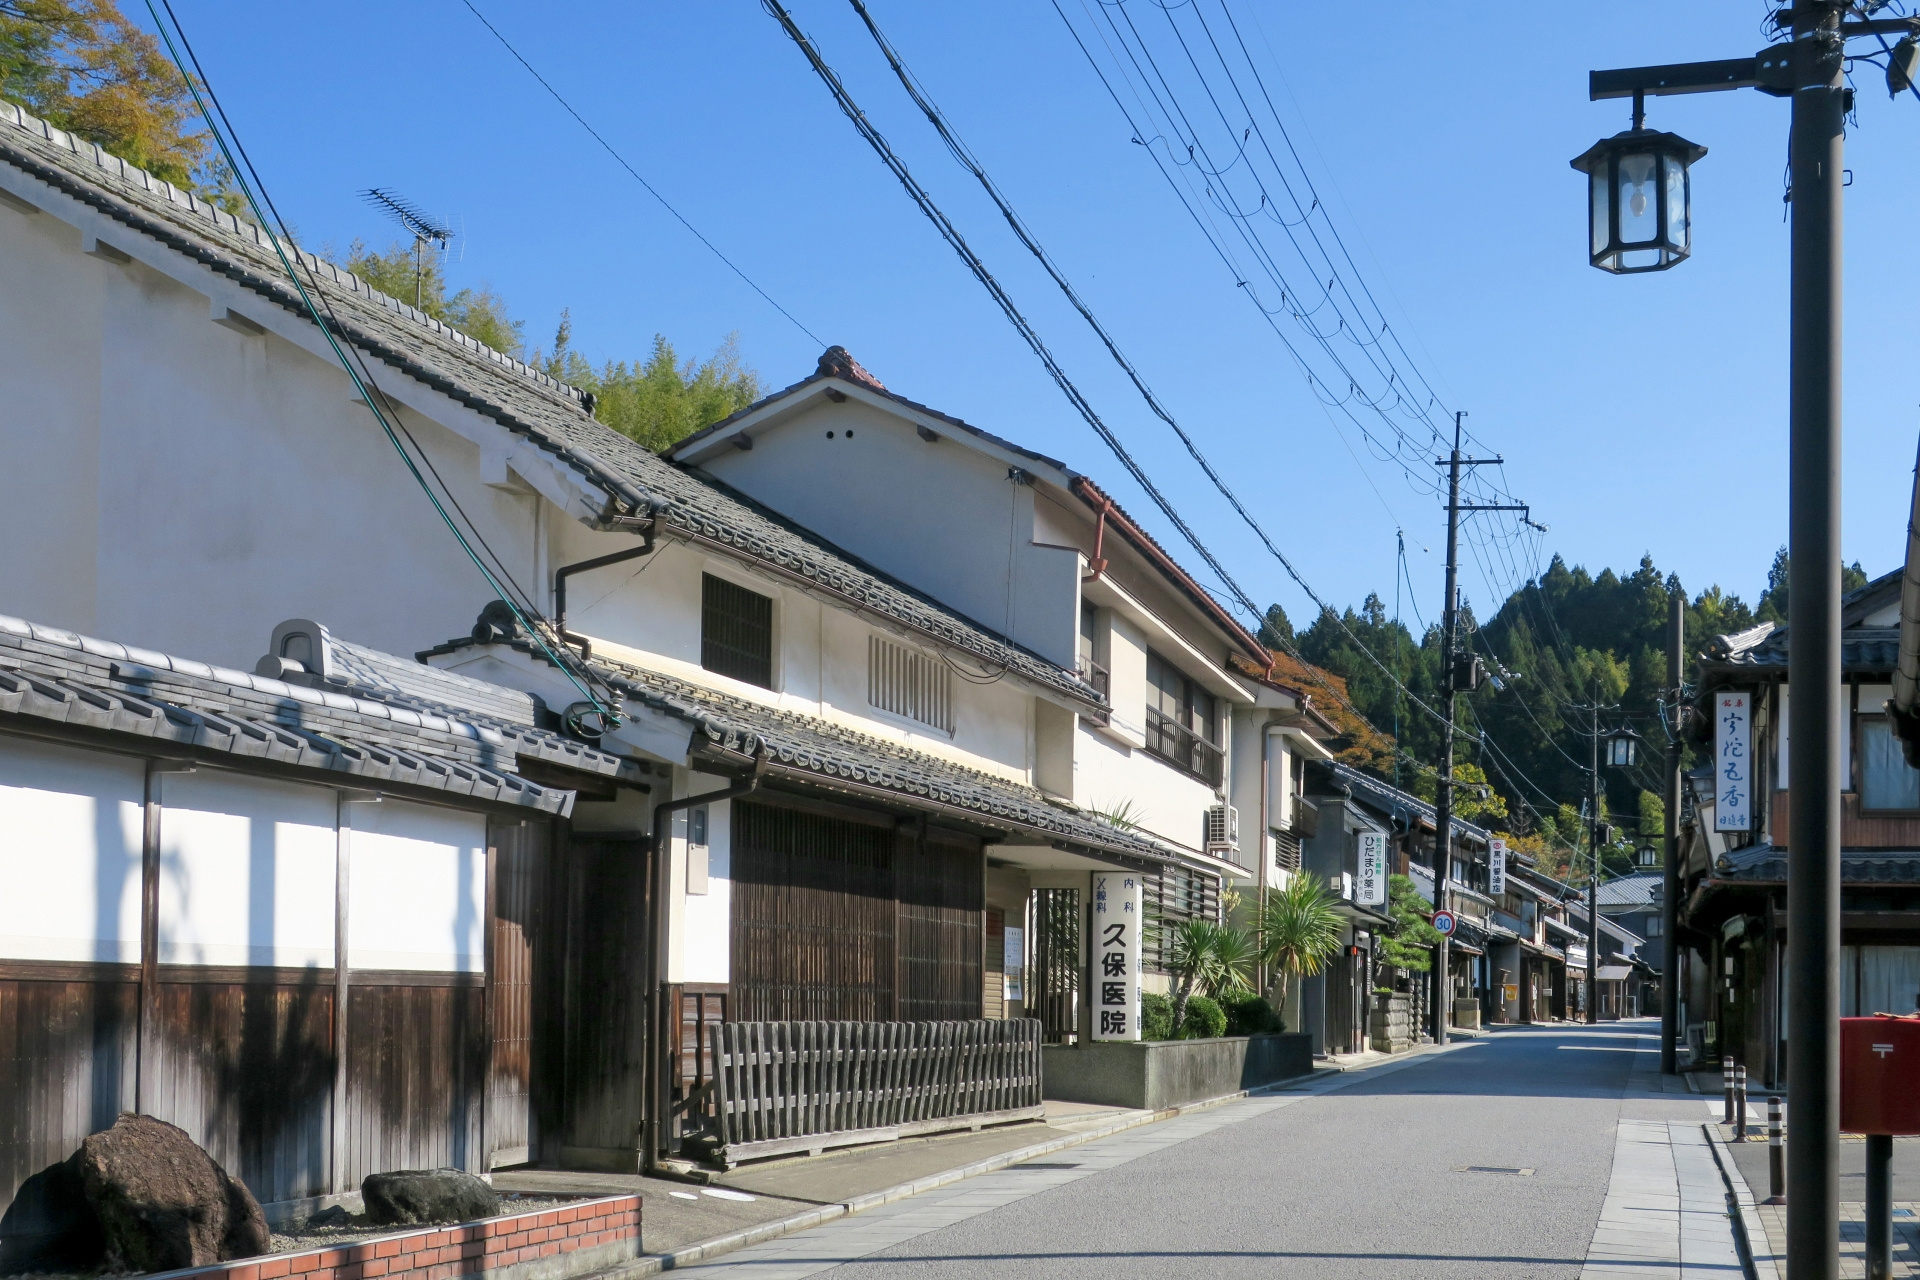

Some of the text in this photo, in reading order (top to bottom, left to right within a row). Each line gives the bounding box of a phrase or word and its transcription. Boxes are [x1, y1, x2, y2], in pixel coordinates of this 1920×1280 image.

[1364, 836, 1375, 900] ひだまり薬局
[1096, 878, 1106, 913] X線科
[1124, 878, 1134, 913] 内科
[1436, 918, 1451, 930] 30
[1101, 924, 1126, 1035] 久保医院
